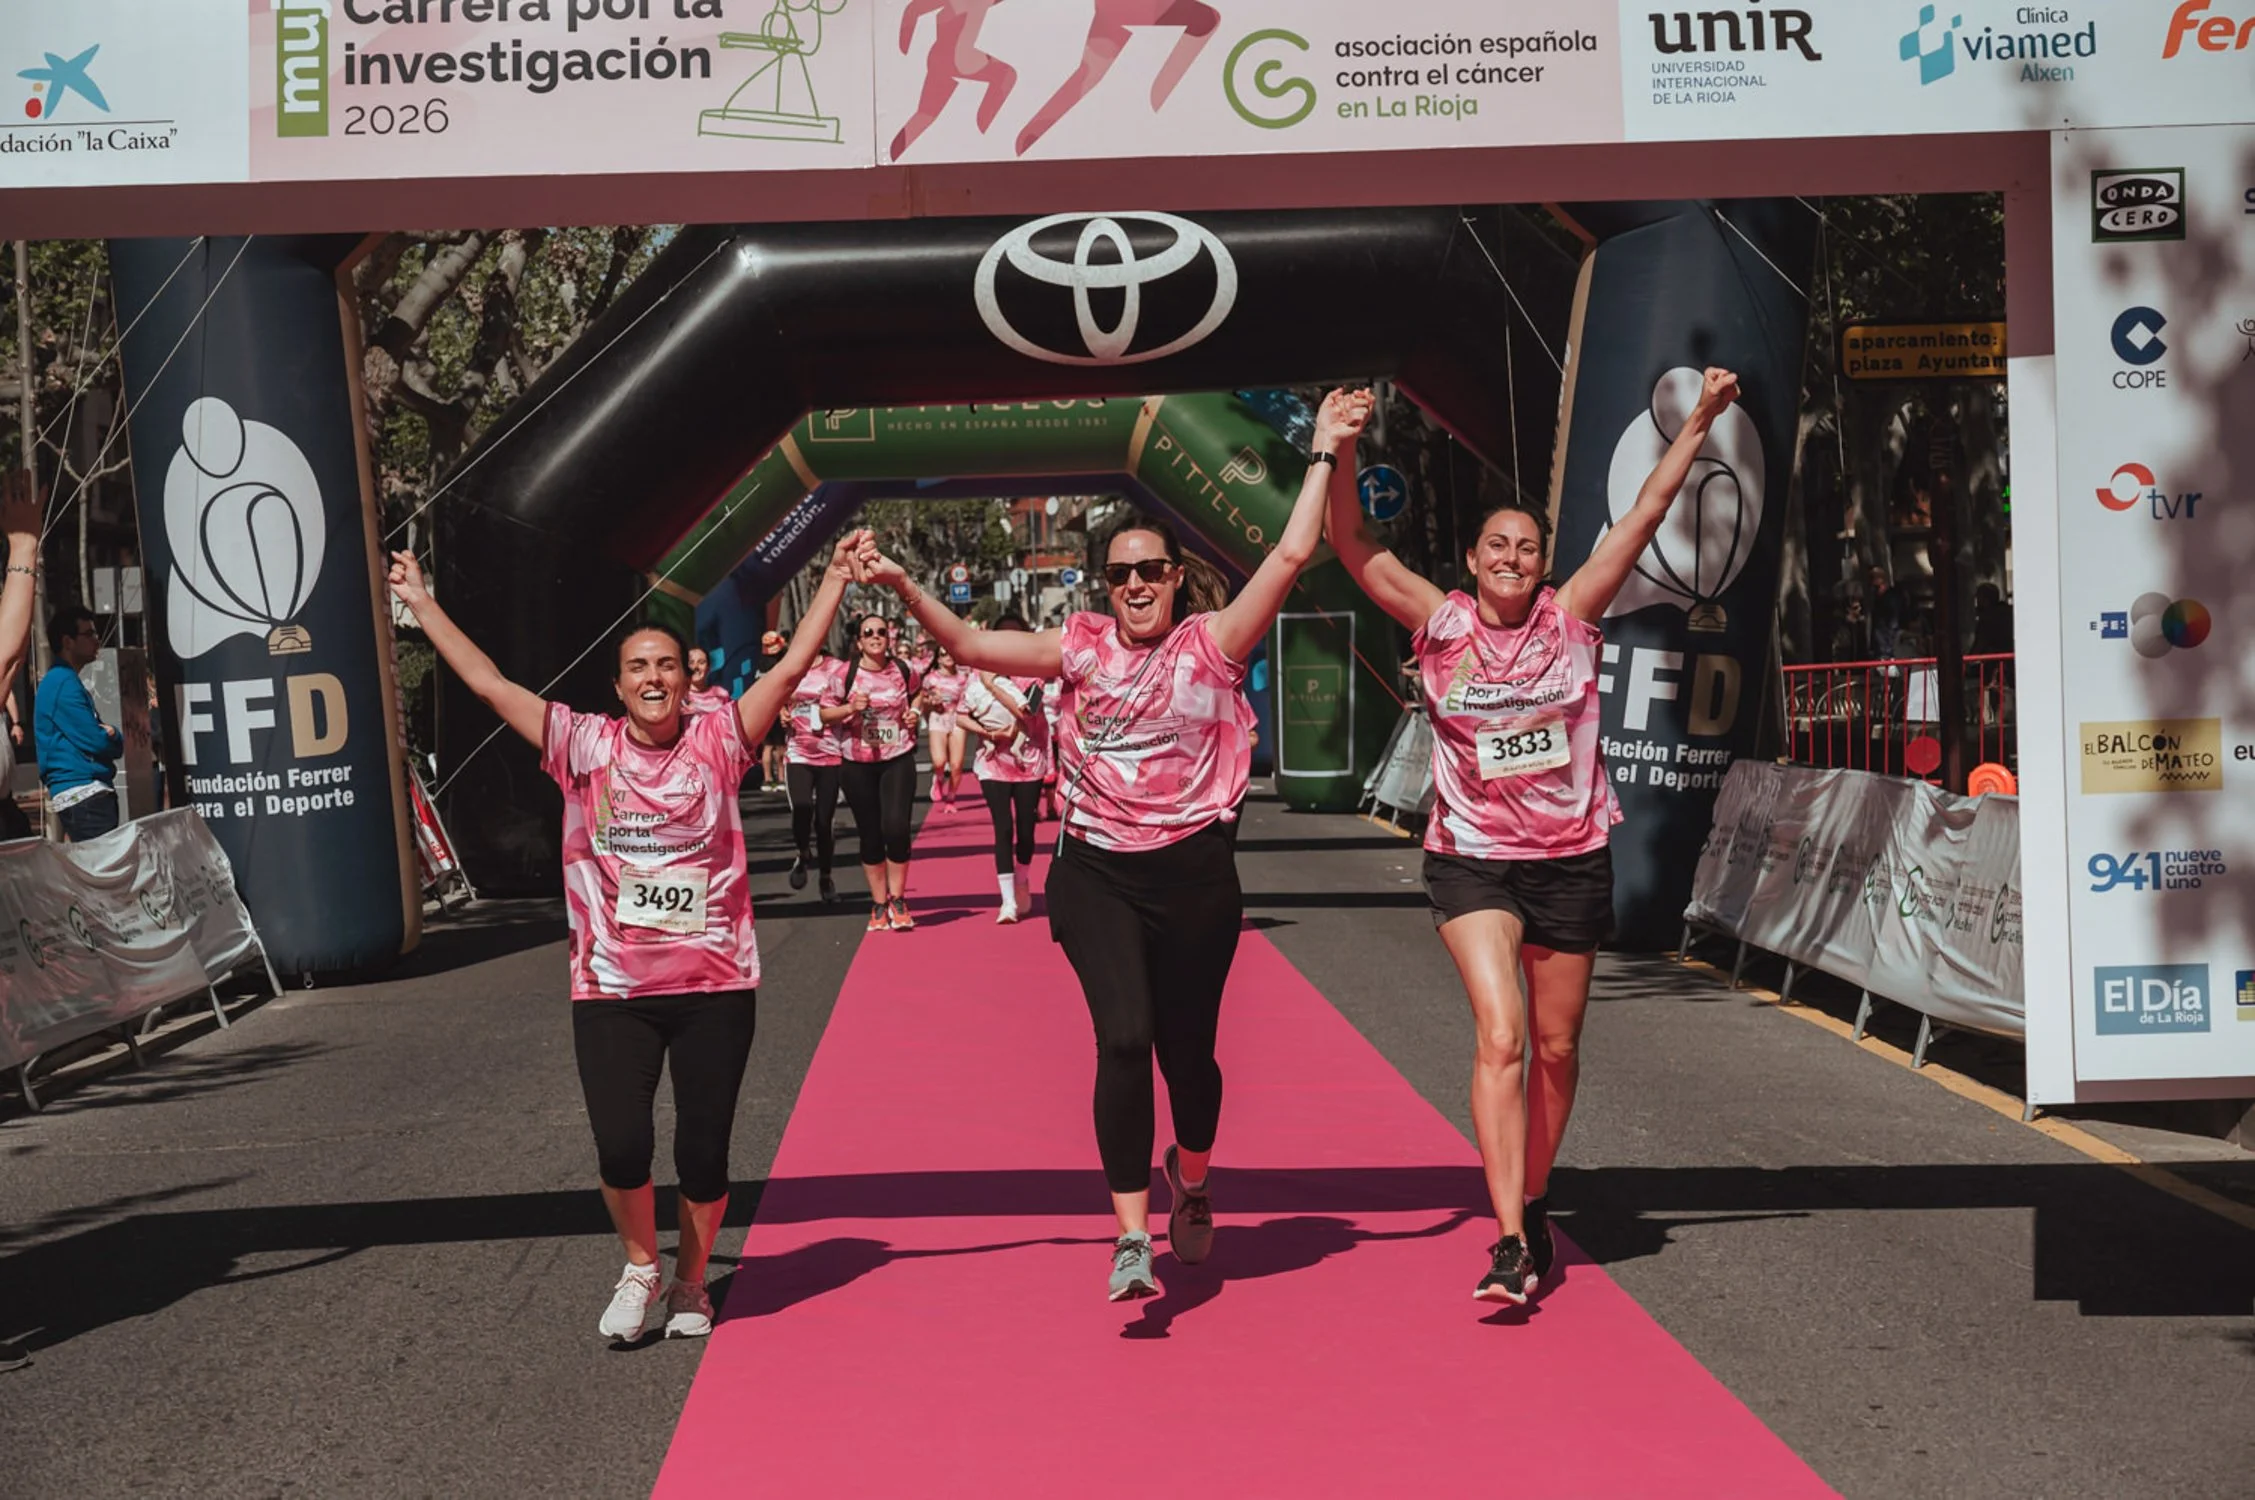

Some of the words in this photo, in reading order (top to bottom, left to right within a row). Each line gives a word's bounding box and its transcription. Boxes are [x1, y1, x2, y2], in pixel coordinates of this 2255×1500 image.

[2016, 7, 2068, 25] Clínica
[1335, 33, 1472, 58] asociación
[1479, 30, 1597, 58] española
[1963, 21, 2097, 61] viamed
[345, 36, 711, 94] investigación
[1335, 69, 1419, 87] contra
[1427, 64, 1449, 85] el
[1456, 62, 1545, 84] cáncer
[1651, 60, 1745, 74] UNIVERSIDAD
[1652, 75, 1767, 89] INTERNACIONAL
[1337, 100, 1368, 118] en
[1376, 96, 1407, 117] La
[1415, 94, 1479, 120] Rioja
[1653, 93, 1671, 105] DE
[1675, 92, 1693, 104] LA
[1696, 91, 1736, 104] RIOJA
[344, 98, 449, 135] 2026
[2106, 184, 2169, 200] ONDA
[2111, 210, 2169, 226] CERO
[1850, 356, 1903, 375] plaza
[2112, 371, 2167, 389] COPE
[887, 421, 932, 431] HECHO
[941, 420, 957, 430] EN
[965, 418, 1018, 430] ESPAÑA
[1026, 418, 1069, 428] DESDE
[2146, 488, 2203, 520] tvr
[174, 672, 349, 765] FFD
[1491, 728, 1552, 760] 3833
[2085, 743, 2097, 755] EL
[2097, 728, 2181, 753] BALCÓN
[1675, 744, 1731, 765] Ferrer
[185, 771, 281, 795] Fundación
[287, 764, 352, 788] Ferrer
[1615, 764, 1638, 783] el
[191, 801, 225, 818] ara
[234, 798, 255, 817] el
[266, 788, 355, 816] Deporte
[2165, 850, 2222, 863] nueve
[2087, 852, 2162, 892] 941
[2165, 862, 2226, 876] cuatro
[2166, 876, 2202, 889] uno
[633, 883, 694, 913] 3492
[2104, 976, 2134, 1013] El
[2141, 979, 2203, 1012] Día
[2139, 1012, 2155, 1024] de
[2157, 1012, 2172, 1023] La
[2175, 1011, 2204, 1025] Rioja
